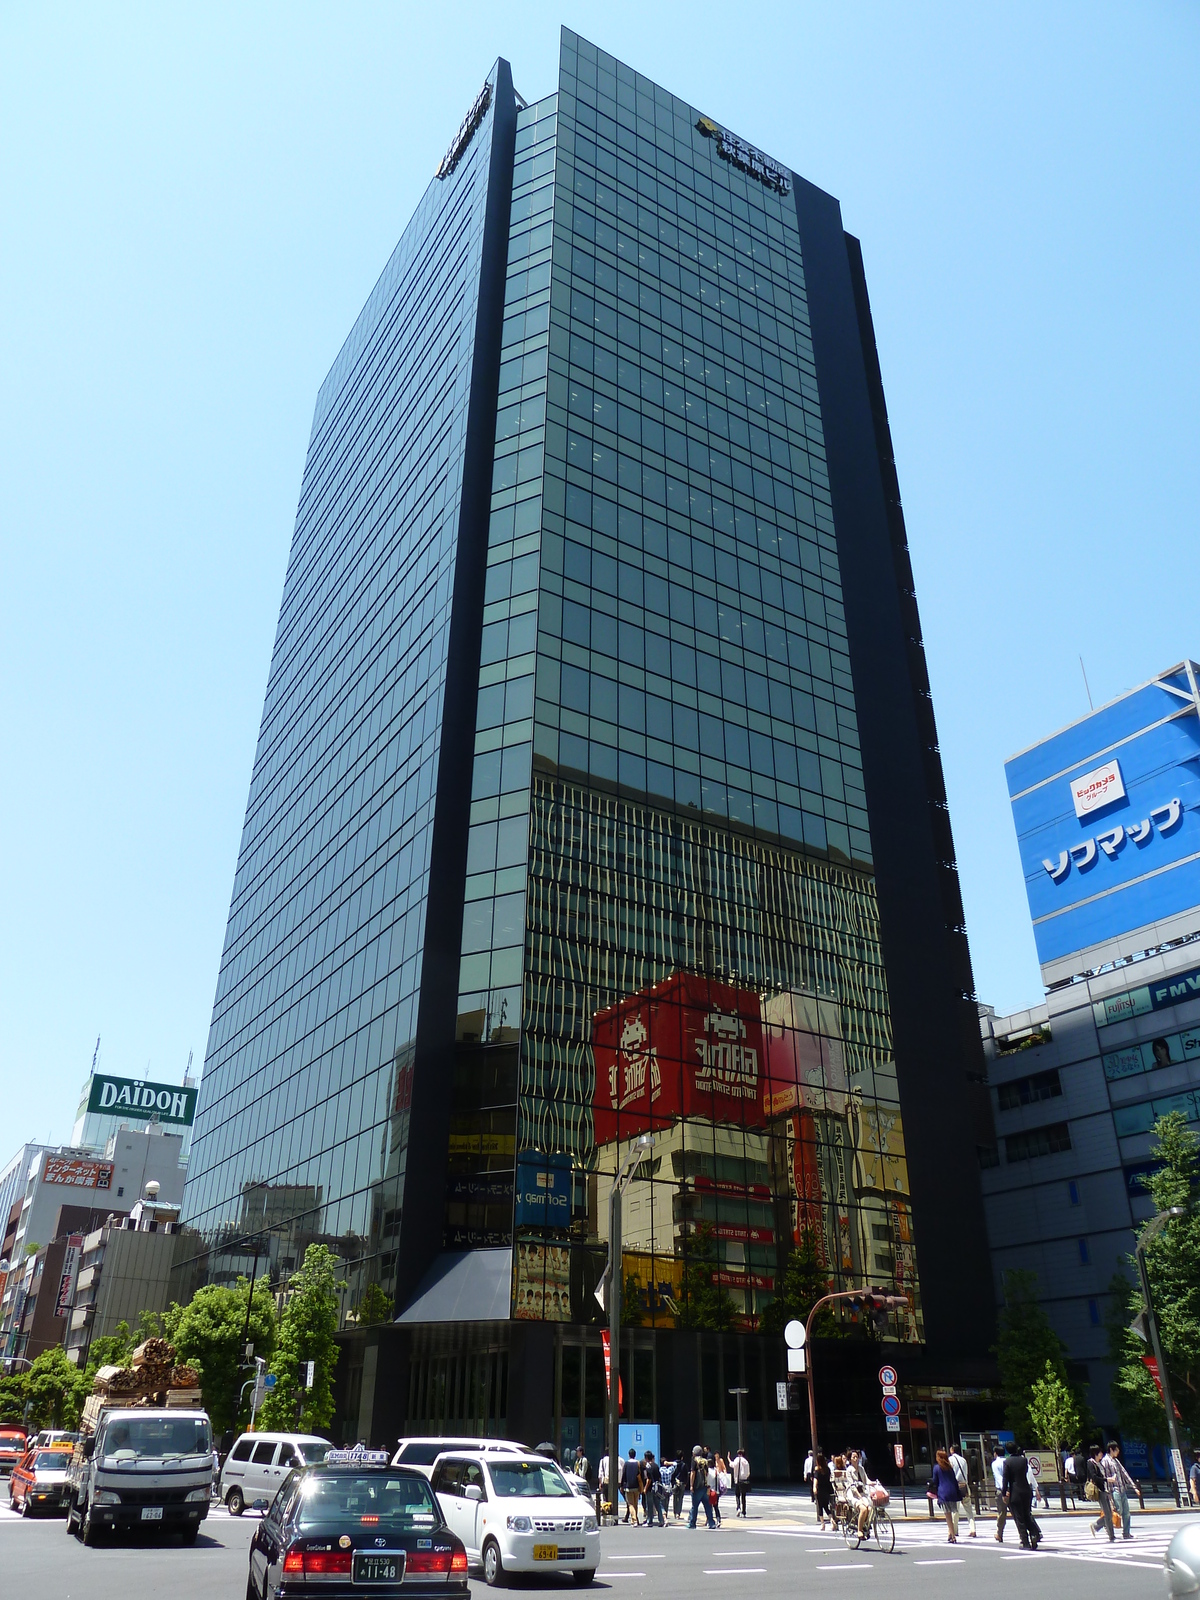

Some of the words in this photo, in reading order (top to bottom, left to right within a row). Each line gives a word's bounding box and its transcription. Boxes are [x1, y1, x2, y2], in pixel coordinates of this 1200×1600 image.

[722, 140, 792, 190] 秋葉原ビル
[1076, 774, 1116, 798] ビックカメラ
[1086, 786, 1108, 801] グループ
[1041, 797, 1181, 879] ソフマップ
[1107, 997, 1136, 1014] FUJITSU
[47, 1163, 97, 1177] インターネット
[45, 1172, 96, 1187] まんが喫茶
[367, 1565, 396, 1579] 11-48
